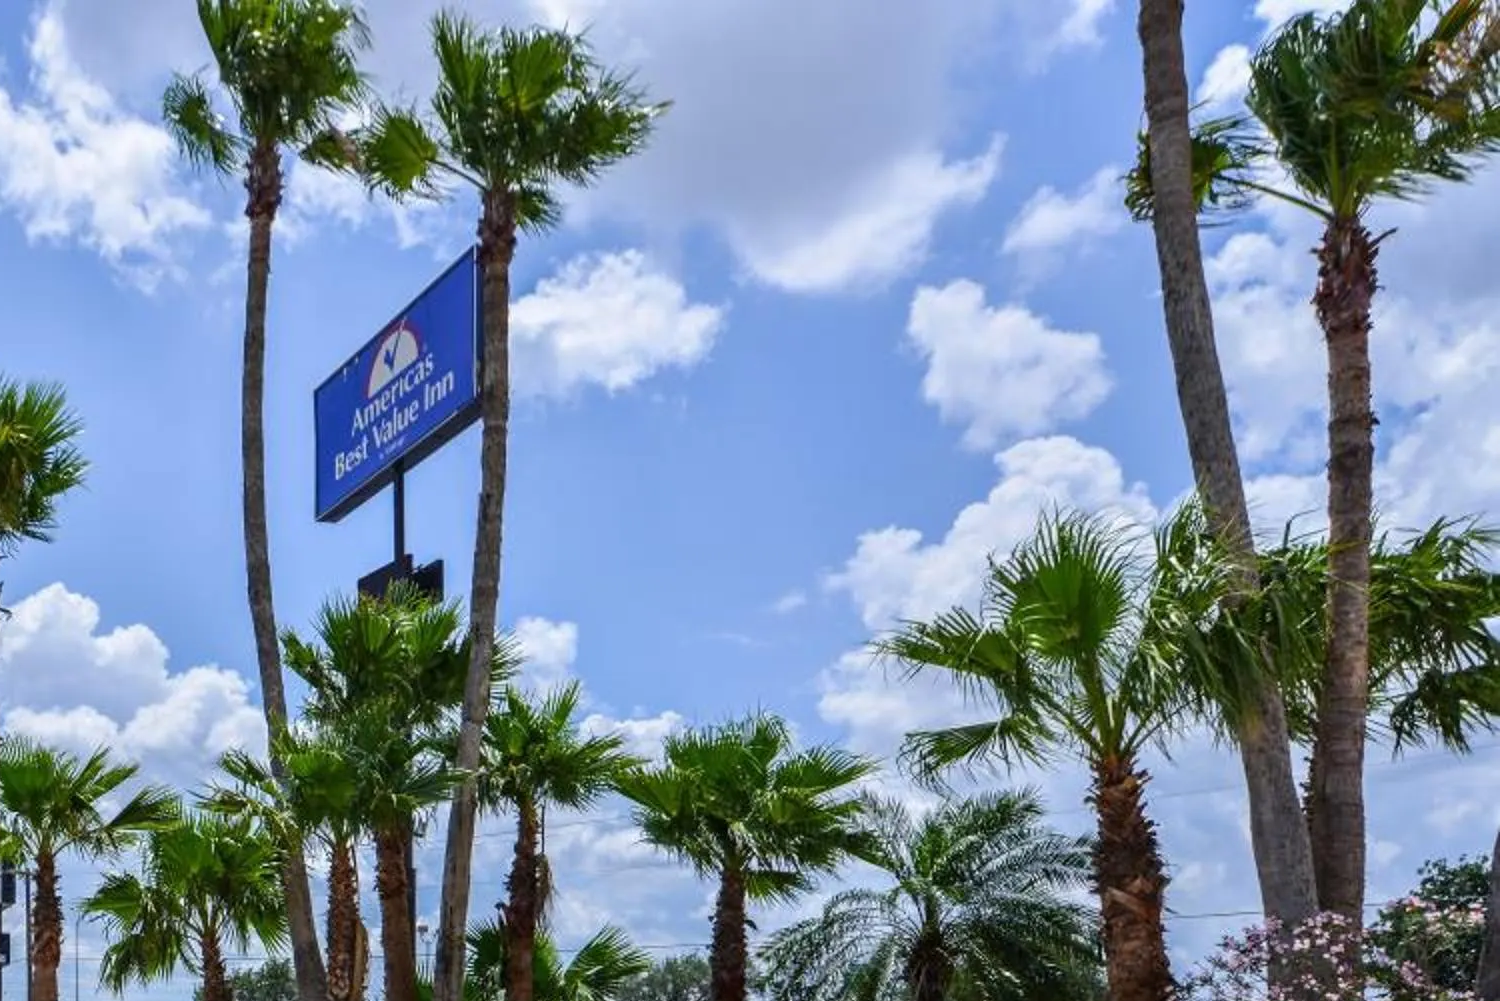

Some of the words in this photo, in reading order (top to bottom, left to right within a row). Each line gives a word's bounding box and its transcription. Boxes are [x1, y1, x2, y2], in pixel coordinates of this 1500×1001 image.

[335, 435, 369, 481] Best
[372, 399, 419, 449] Value
[424, 370, 454, 412] Inn
[351, 352, 435, 437] Americas
